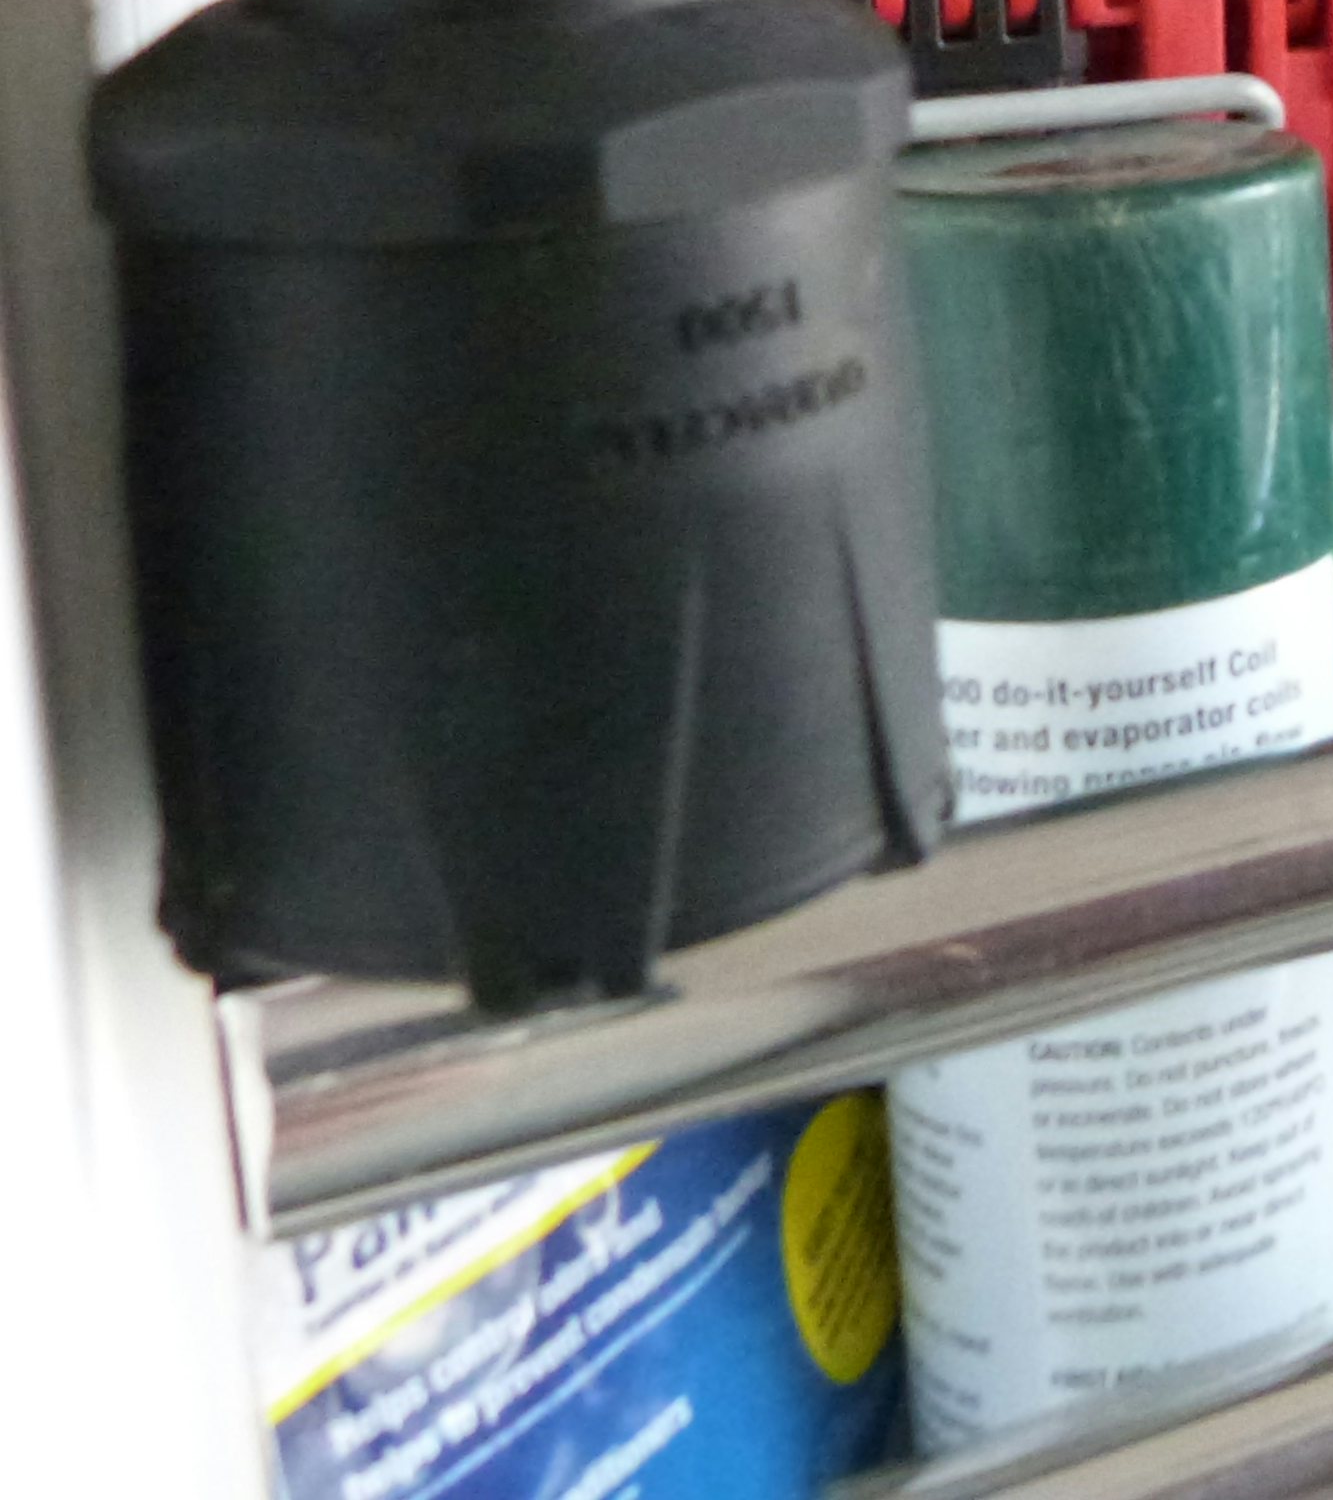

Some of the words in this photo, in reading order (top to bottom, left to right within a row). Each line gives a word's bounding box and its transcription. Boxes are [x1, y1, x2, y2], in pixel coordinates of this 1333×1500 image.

[993, 656, 1217, 711] do-it-yourself
[1228, 639, 1277, 677] Coil
[994, 723, 1049, 750] and
[1064, 702, 1237, 751] evaporator
